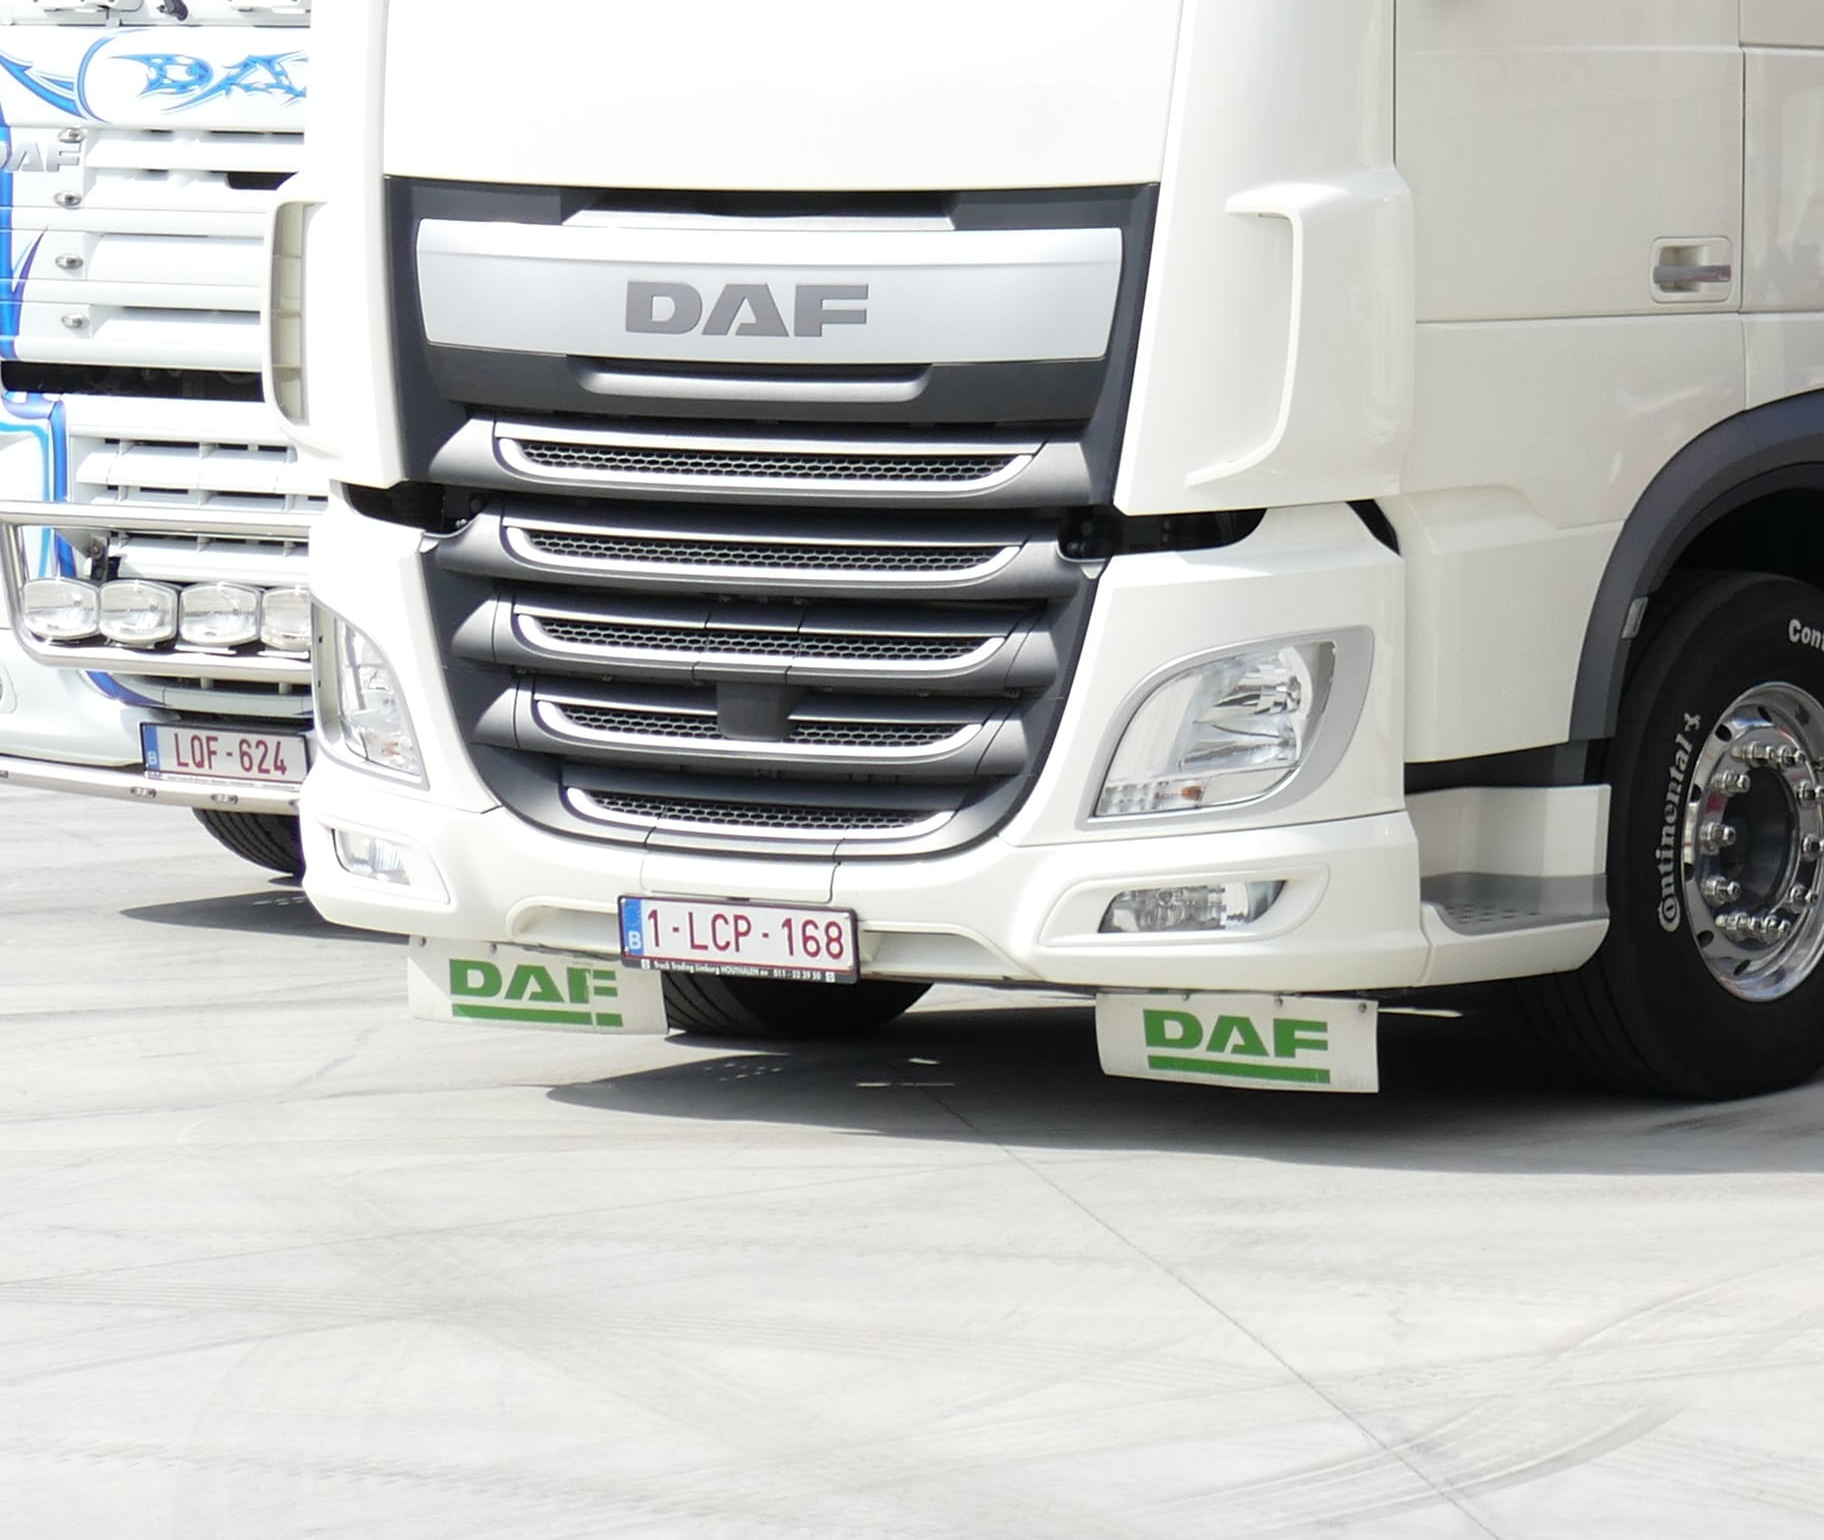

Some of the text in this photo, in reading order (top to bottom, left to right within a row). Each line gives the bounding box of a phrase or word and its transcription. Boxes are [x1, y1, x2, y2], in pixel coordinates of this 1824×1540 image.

[624, 279, 870, 338] DAF
[1656, 733, 1694, 933] Continental
[628, 930, 641, 950] B
[450, 958, 618, 1005] DAF
[1143, 1008, 1328, 1058] DAF
